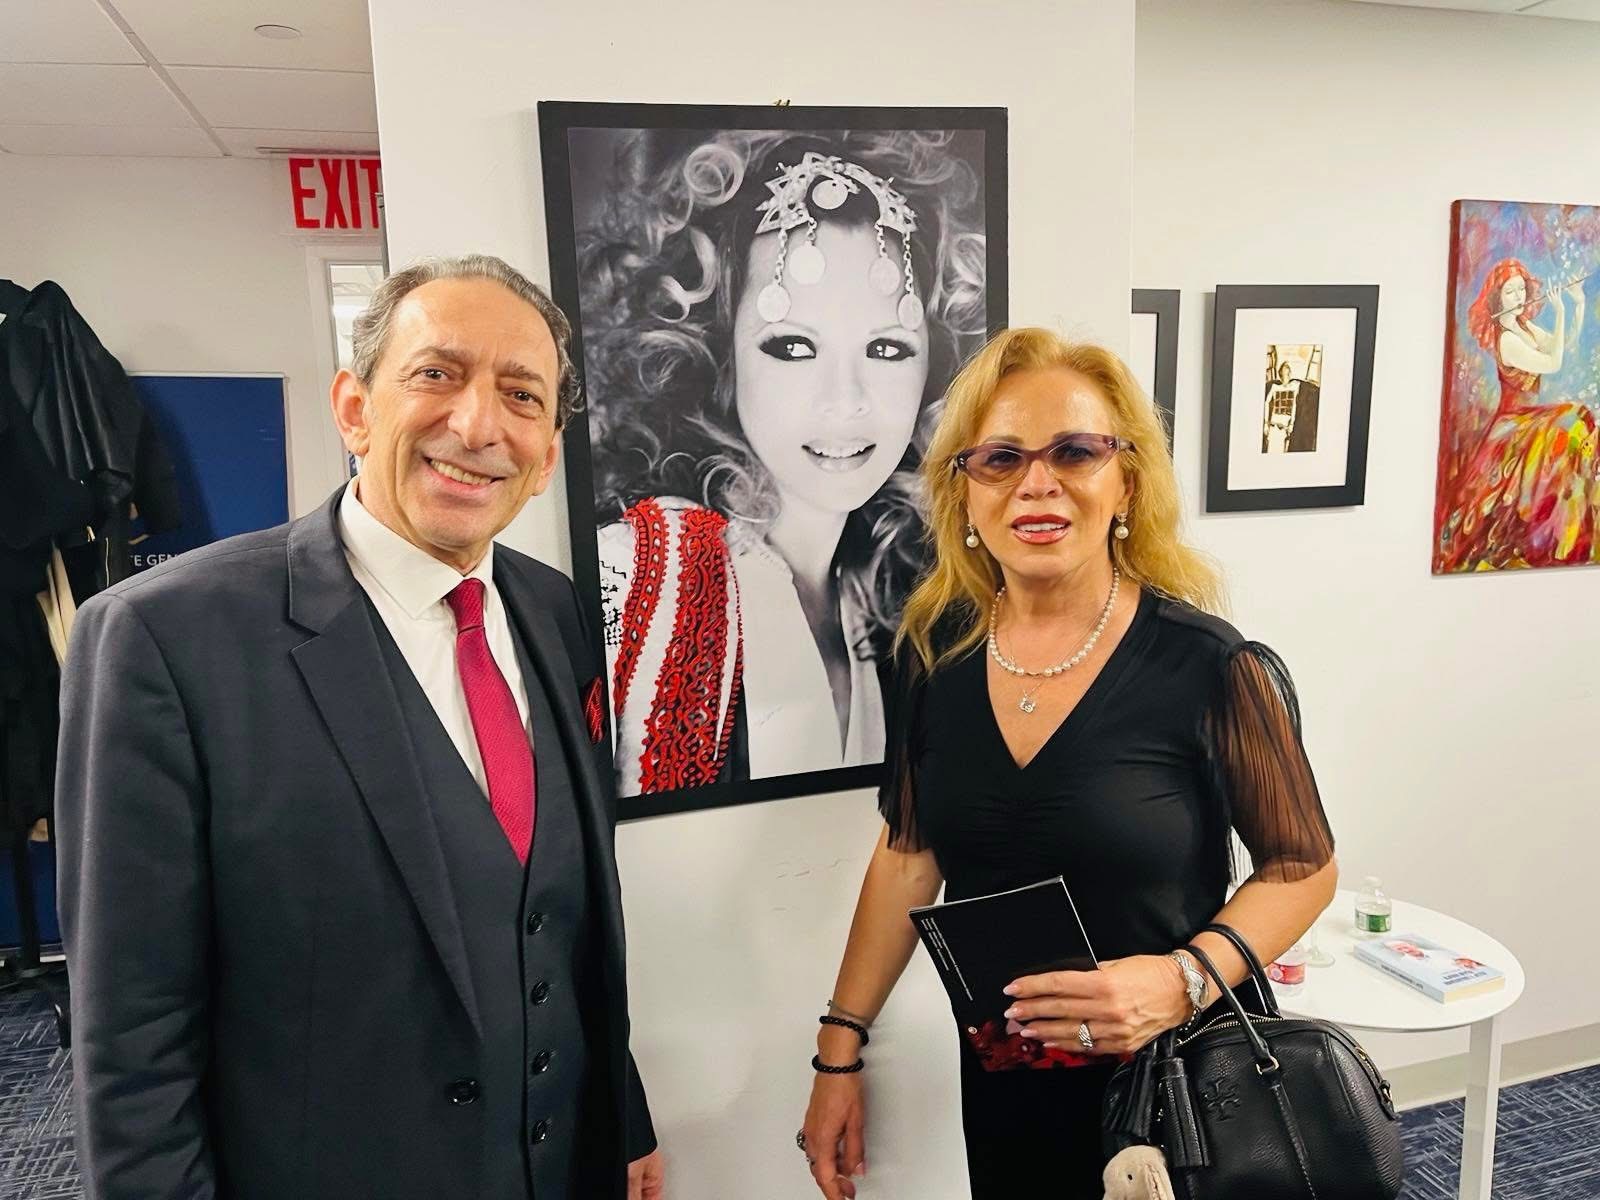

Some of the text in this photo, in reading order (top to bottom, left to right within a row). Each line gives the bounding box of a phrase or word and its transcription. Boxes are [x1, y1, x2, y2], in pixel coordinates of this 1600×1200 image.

[289, 158, 382, 229] EXIT
[130, 553, 178, 567] E GE
